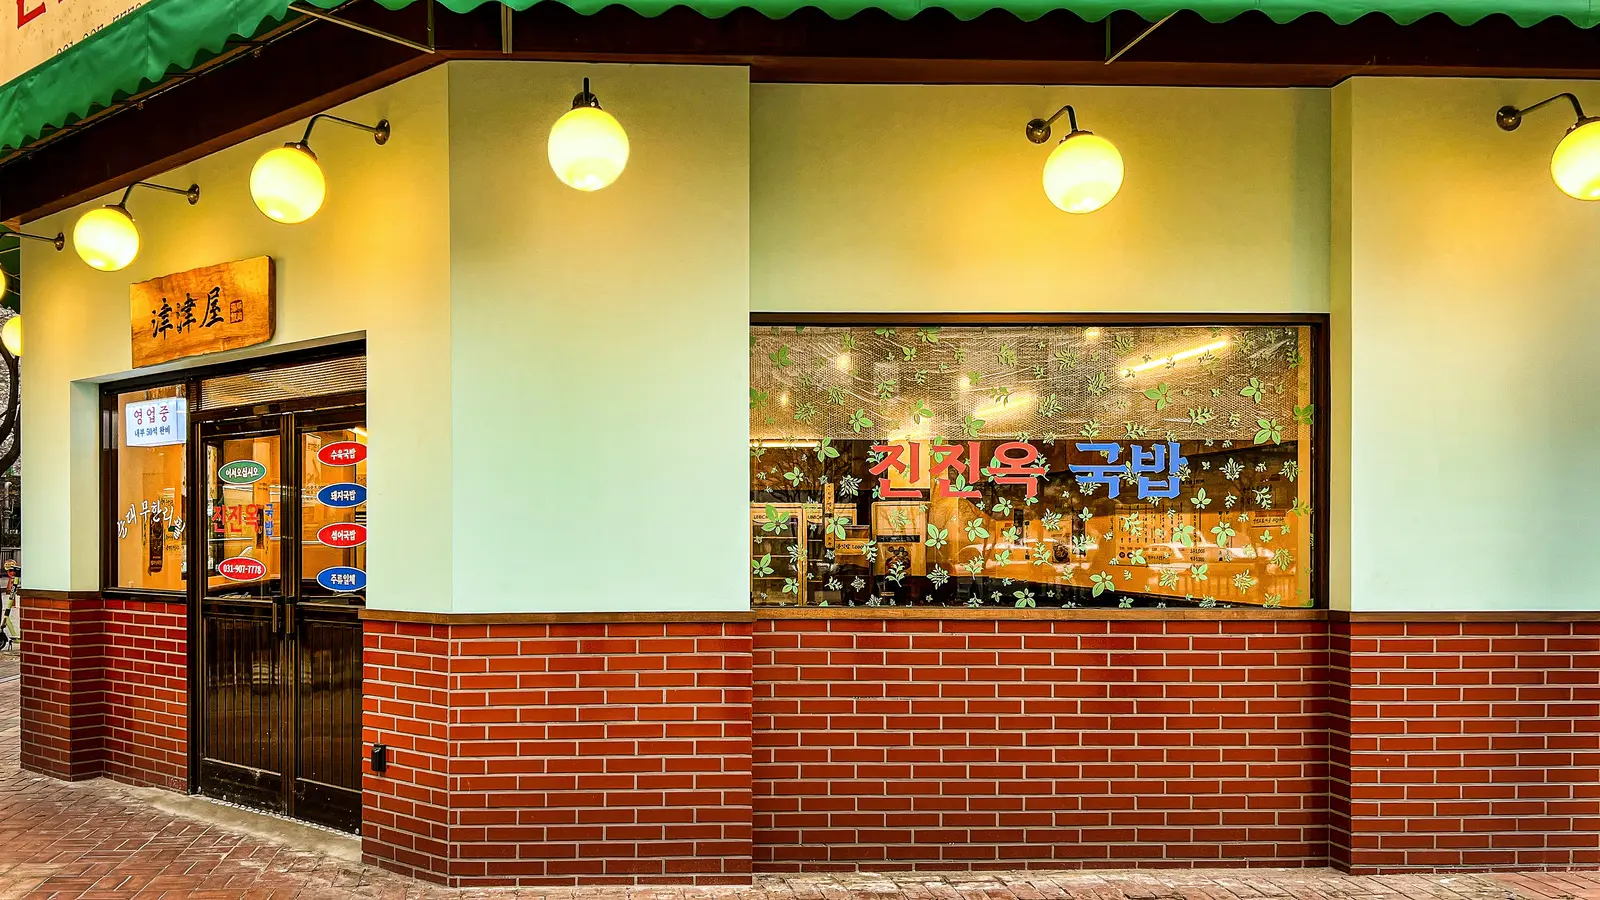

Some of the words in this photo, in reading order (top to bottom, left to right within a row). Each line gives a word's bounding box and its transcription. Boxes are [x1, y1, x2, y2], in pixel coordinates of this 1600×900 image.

[151, 286, 224, 341] 津津屋
[133, 405, 169, 426] 영업중
[134, 428, 145, 438] 내부
[146, 426, 157, 436] 50석
[159, 424, 171, 435] 완비
[330, 447, 357, 461] 수육국밥
[225, 466, 259, 479] 어서오십시오
[868, 441, 1046, 499] 진진옥
[1068, 440, 1190, 500] 국밥
[330, 489, 357, 502] 돼지국밥
[211, 503, 261, 533] 진진옥
[264, 503, 275, 537] 국밥
[222, 564, 262, 575] 031-907-7778
[330, 573, 356, 586] 주류일체
